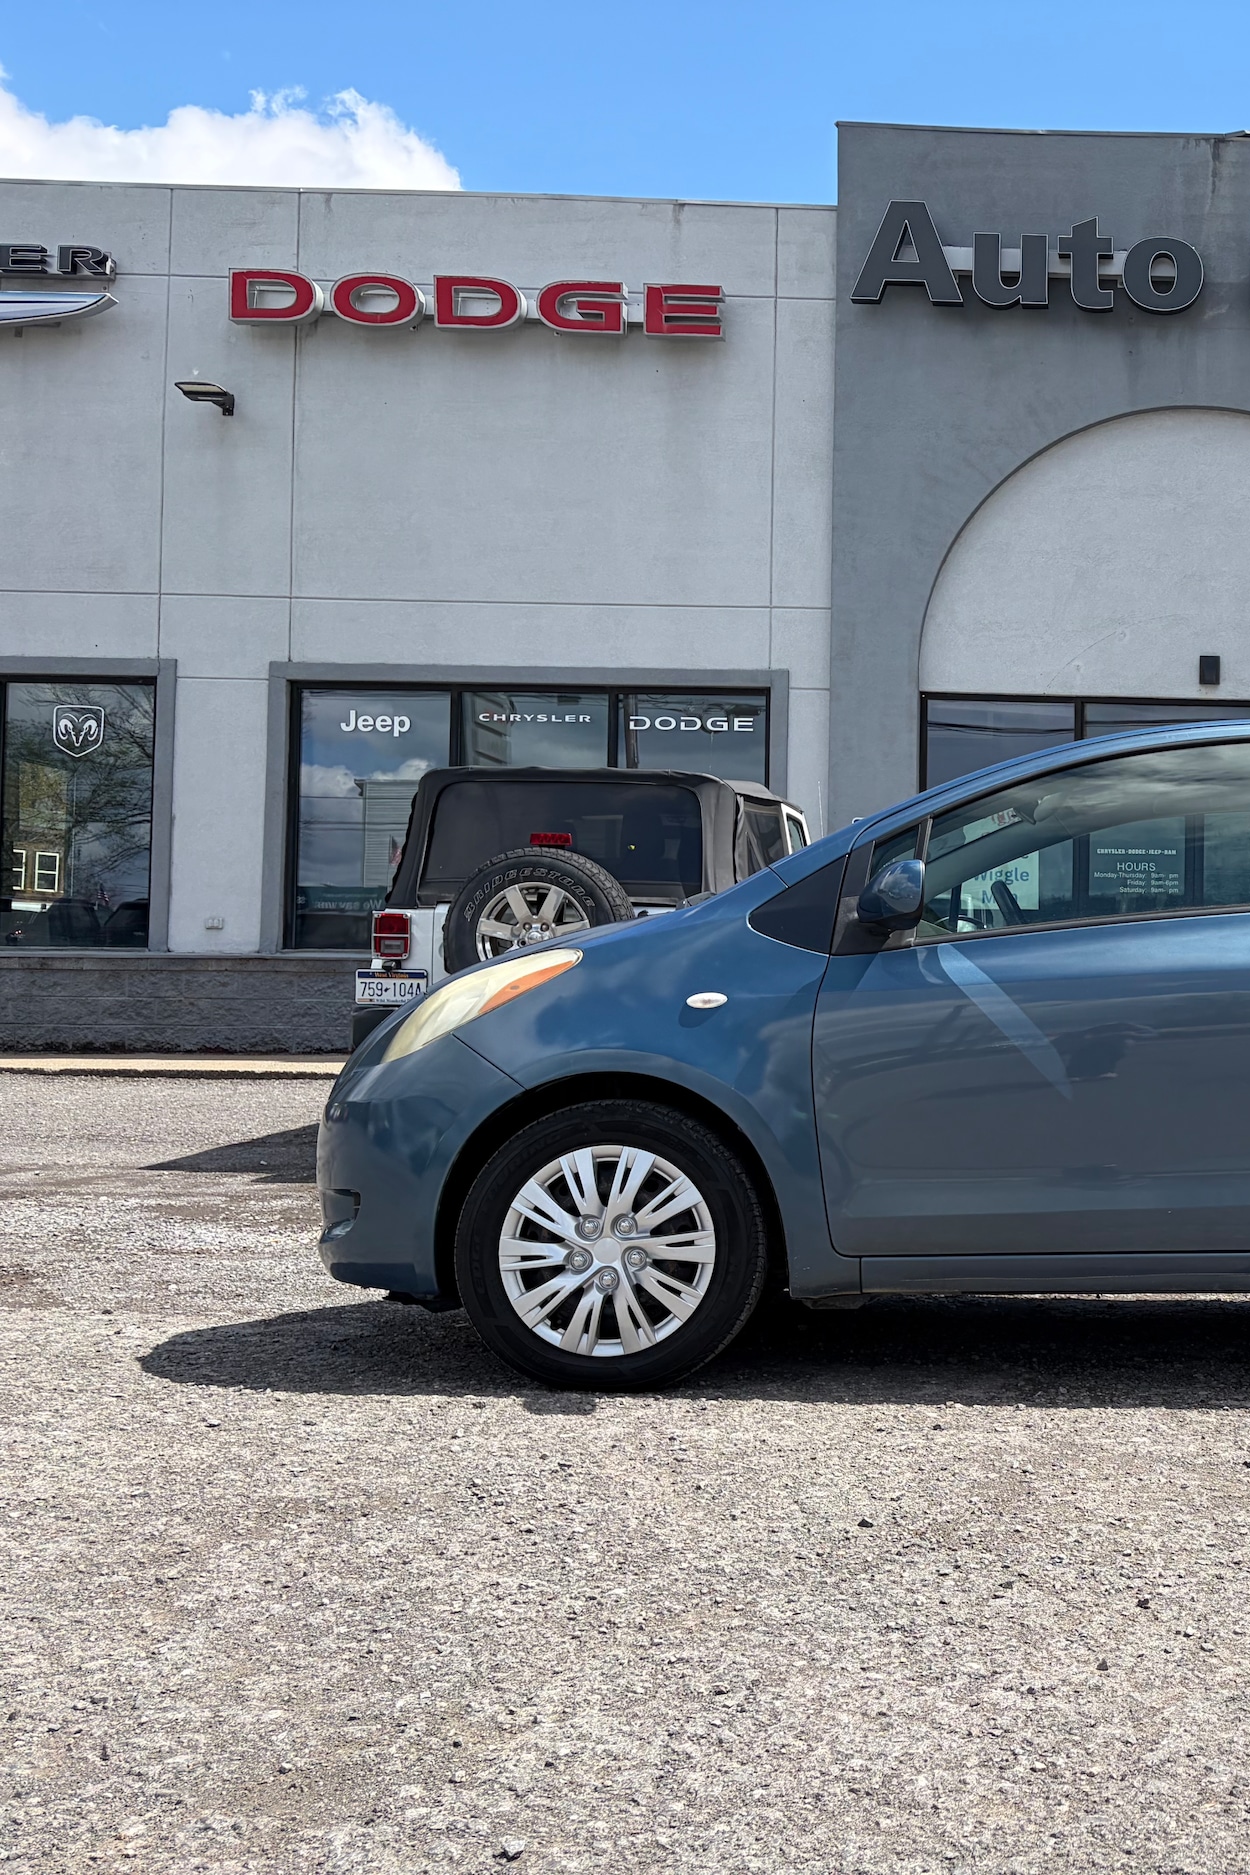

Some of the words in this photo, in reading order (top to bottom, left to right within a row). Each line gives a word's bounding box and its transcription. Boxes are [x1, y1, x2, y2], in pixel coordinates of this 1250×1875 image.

[850, 200, 1205, 316] Auto
[228, 268, 726, 341] DODGE
[340, 709, 411, 737] Jeep
[479, 713, 591, 723] CHRYSLER
[629, 715, 754, 732] DODGE
[1117, 862, 1156, 871] HOURS
[463, 867, 597, 922] BRIDGESTONE
